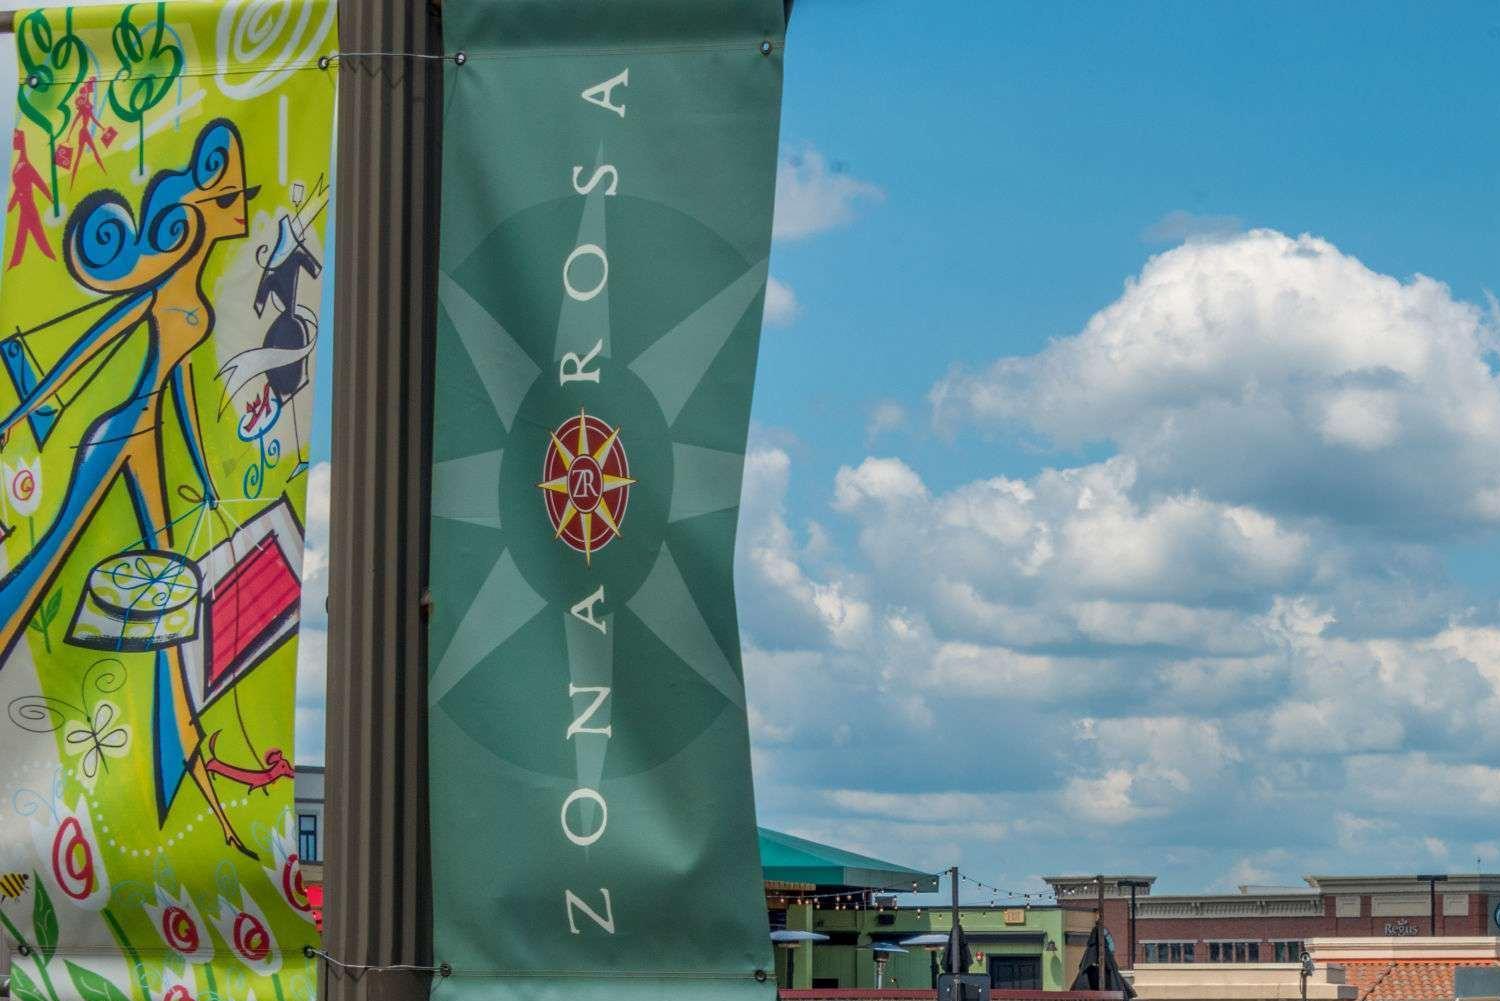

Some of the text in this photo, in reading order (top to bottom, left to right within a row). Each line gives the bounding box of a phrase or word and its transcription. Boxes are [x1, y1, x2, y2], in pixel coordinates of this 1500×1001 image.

[559, 67, 629, 934] ZONA ROSA
[572, 469, 600, 498] ZR
